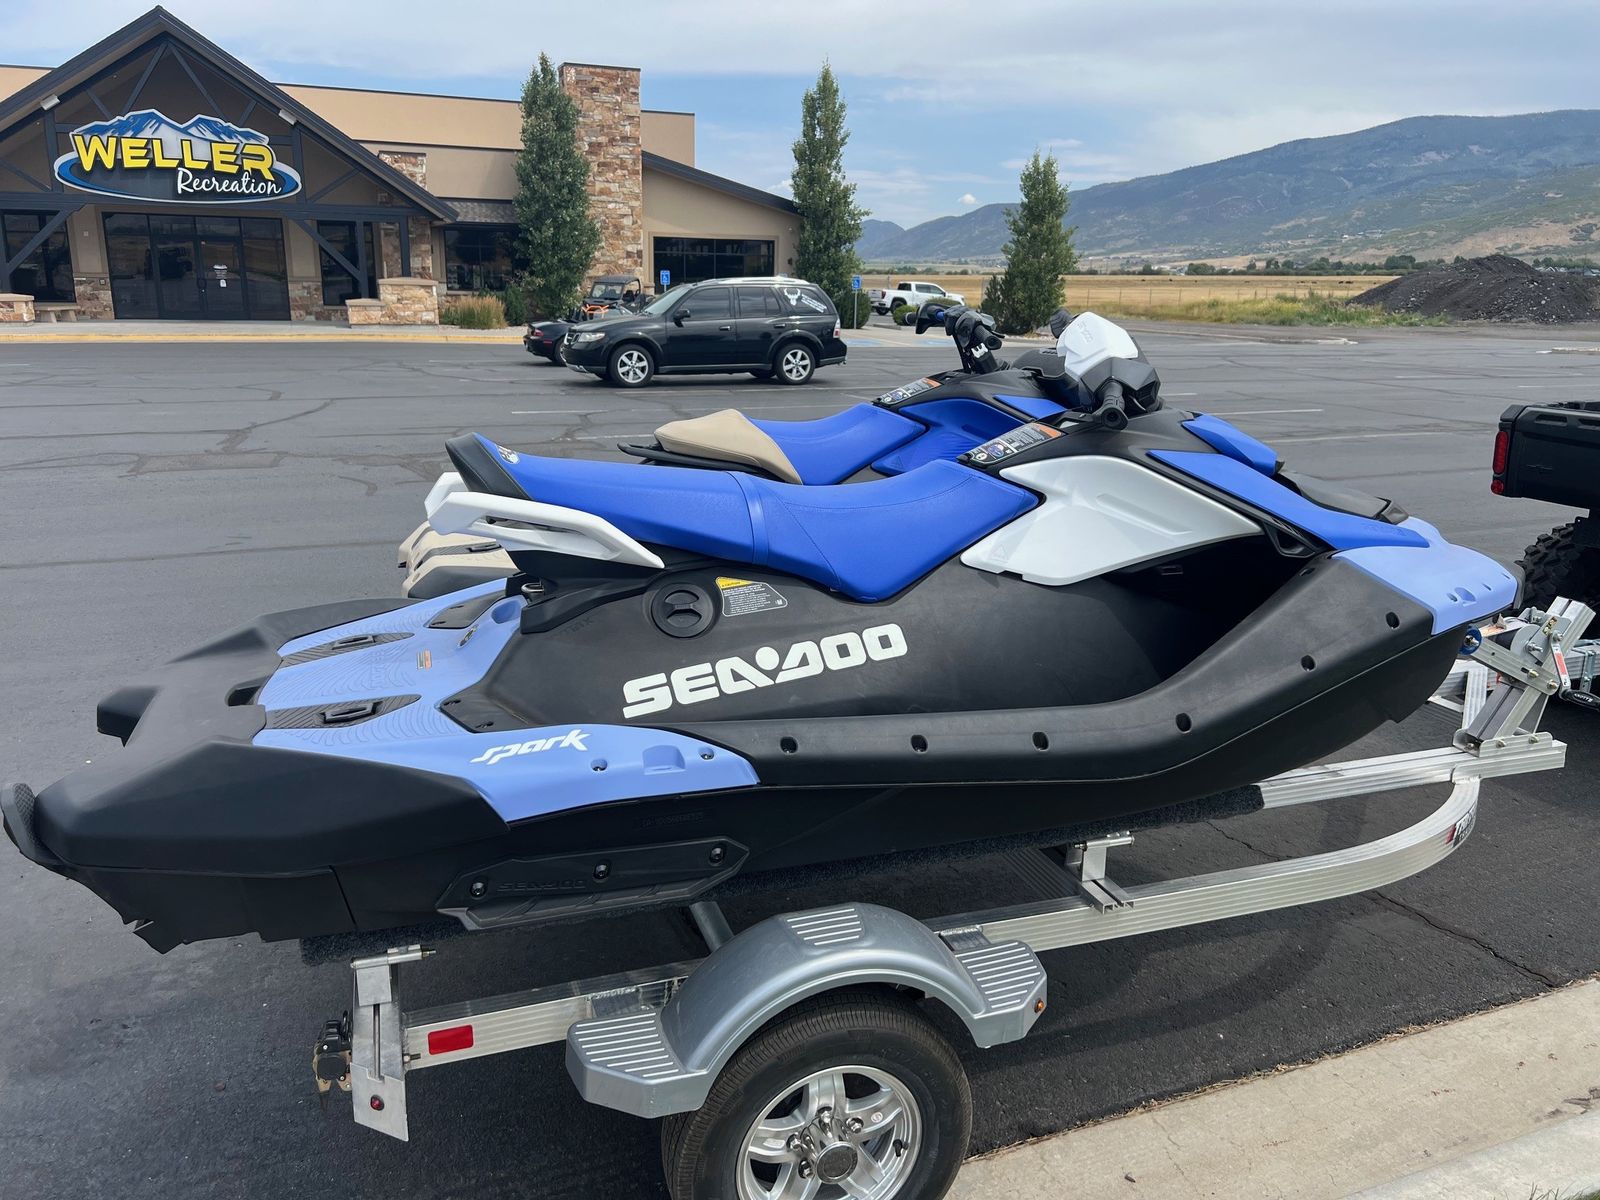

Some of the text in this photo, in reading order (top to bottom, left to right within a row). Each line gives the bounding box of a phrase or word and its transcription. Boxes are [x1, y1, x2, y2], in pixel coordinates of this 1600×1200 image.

[73, 133, 276, 181] WELLER
[177, 167, 283, 195] Recreation
[470, 729, 590, 765] spark
